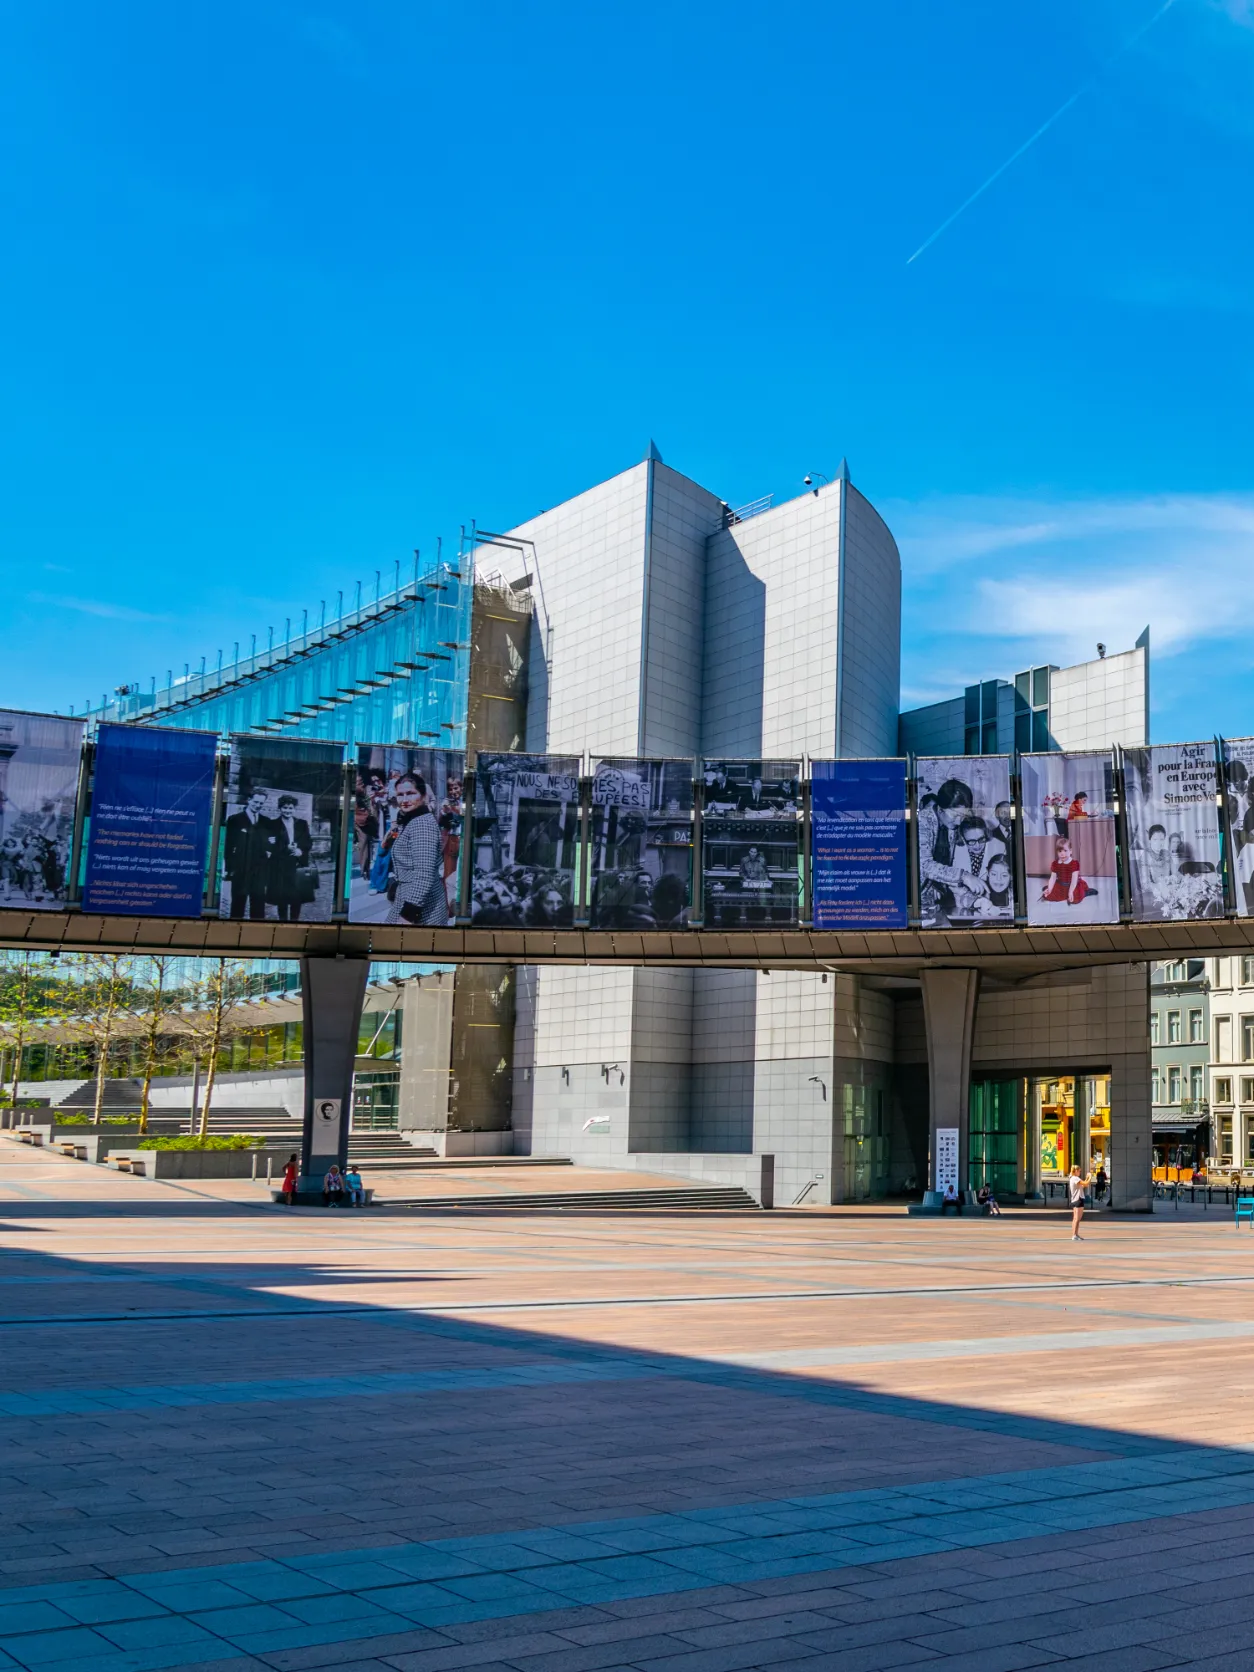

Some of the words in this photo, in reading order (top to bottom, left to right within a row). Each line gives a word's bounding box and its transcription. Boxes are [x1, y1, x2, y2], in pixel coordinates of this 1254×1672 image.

[1181, 746, 1206, 758] Agir
[1158, 763, 1182, 773] pour
[1184, 760, 1193, 769] la
[1167, 774, 1180, 782] en
[517, 773, 543, 788] NOUS
[548, 775, 561, 789] NE
[622, 782, 650, 795] PAS
[1183, 783, 1206, 792] avec
[535, 789, 560, 799] DES
[1164, 793, 1202, 804] Simone
